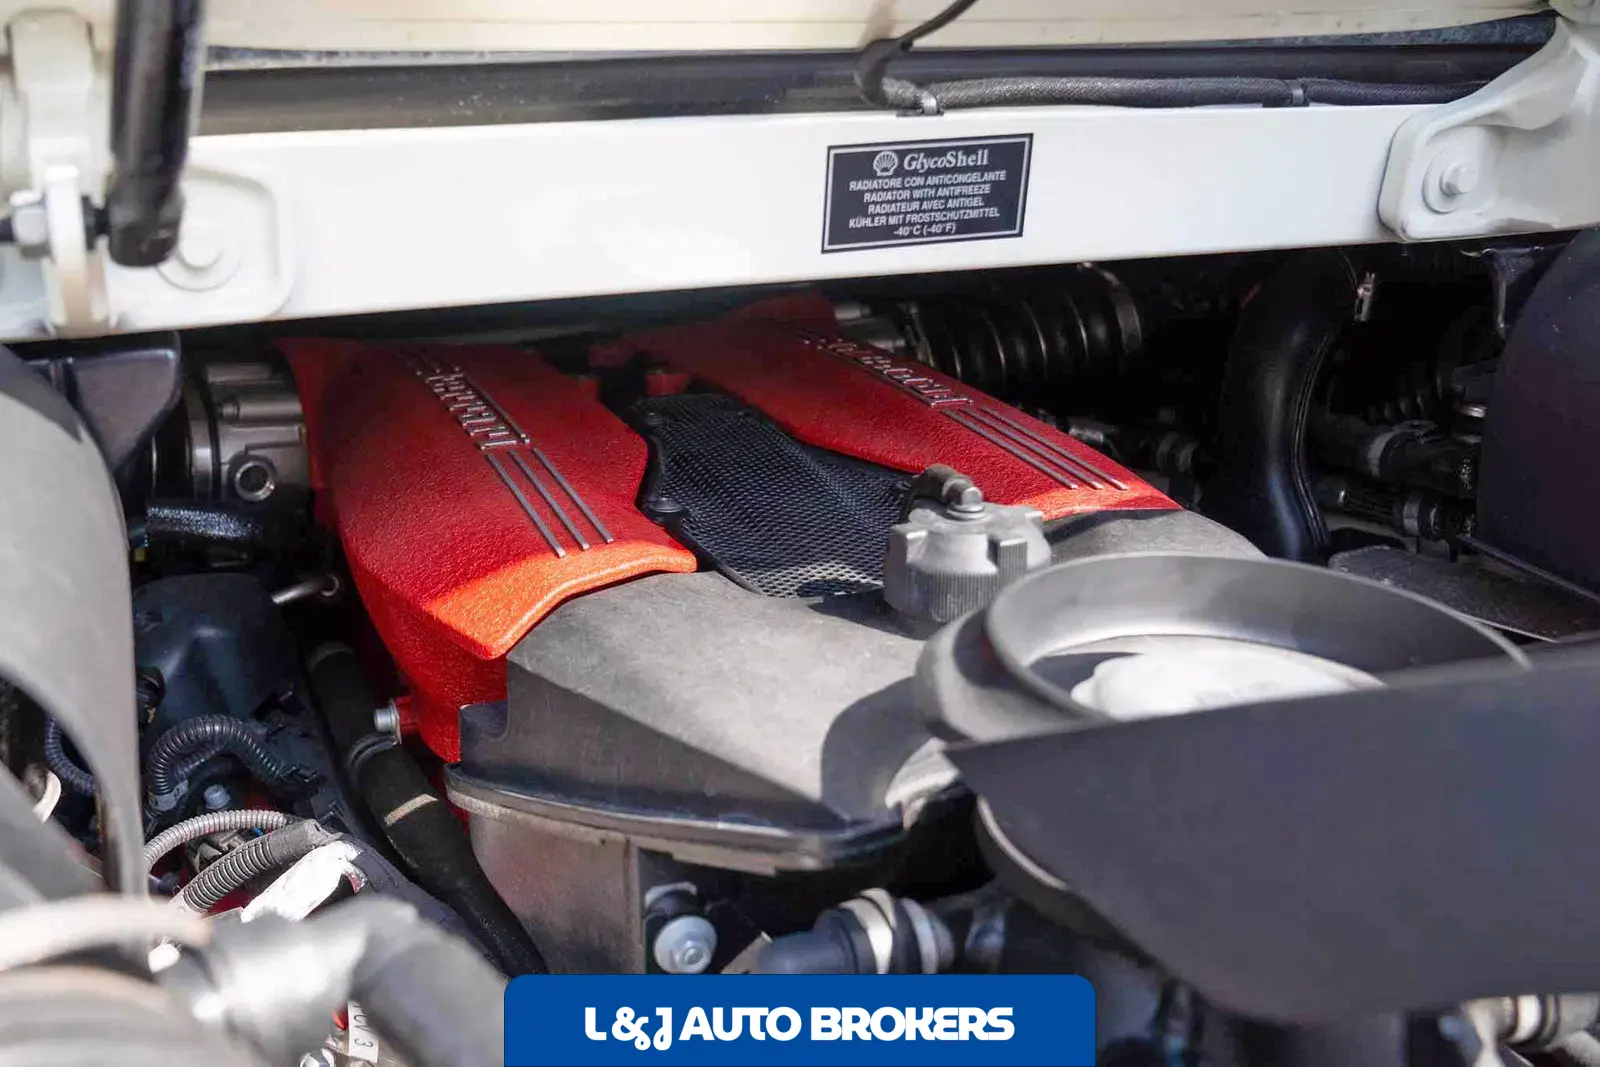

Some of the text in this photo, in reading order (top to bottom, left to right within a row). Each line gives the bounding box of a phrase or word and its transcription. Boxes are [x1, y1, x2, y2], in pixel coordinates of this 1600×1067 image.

[903, 149, 989, 173] GlycoShell
[849, 170, 1007, 191] RADIATORE CON ANTICONGELANTE
[863, 183, 991, 203] RADIATOR WITH ANTIFREEZE
[868, 196, 985, 214] RADIATEUR AVEC ANTIGEL
[849, 207, 1000, 229] KÜHLER MIT FROSTSCHUTZMITTEL
